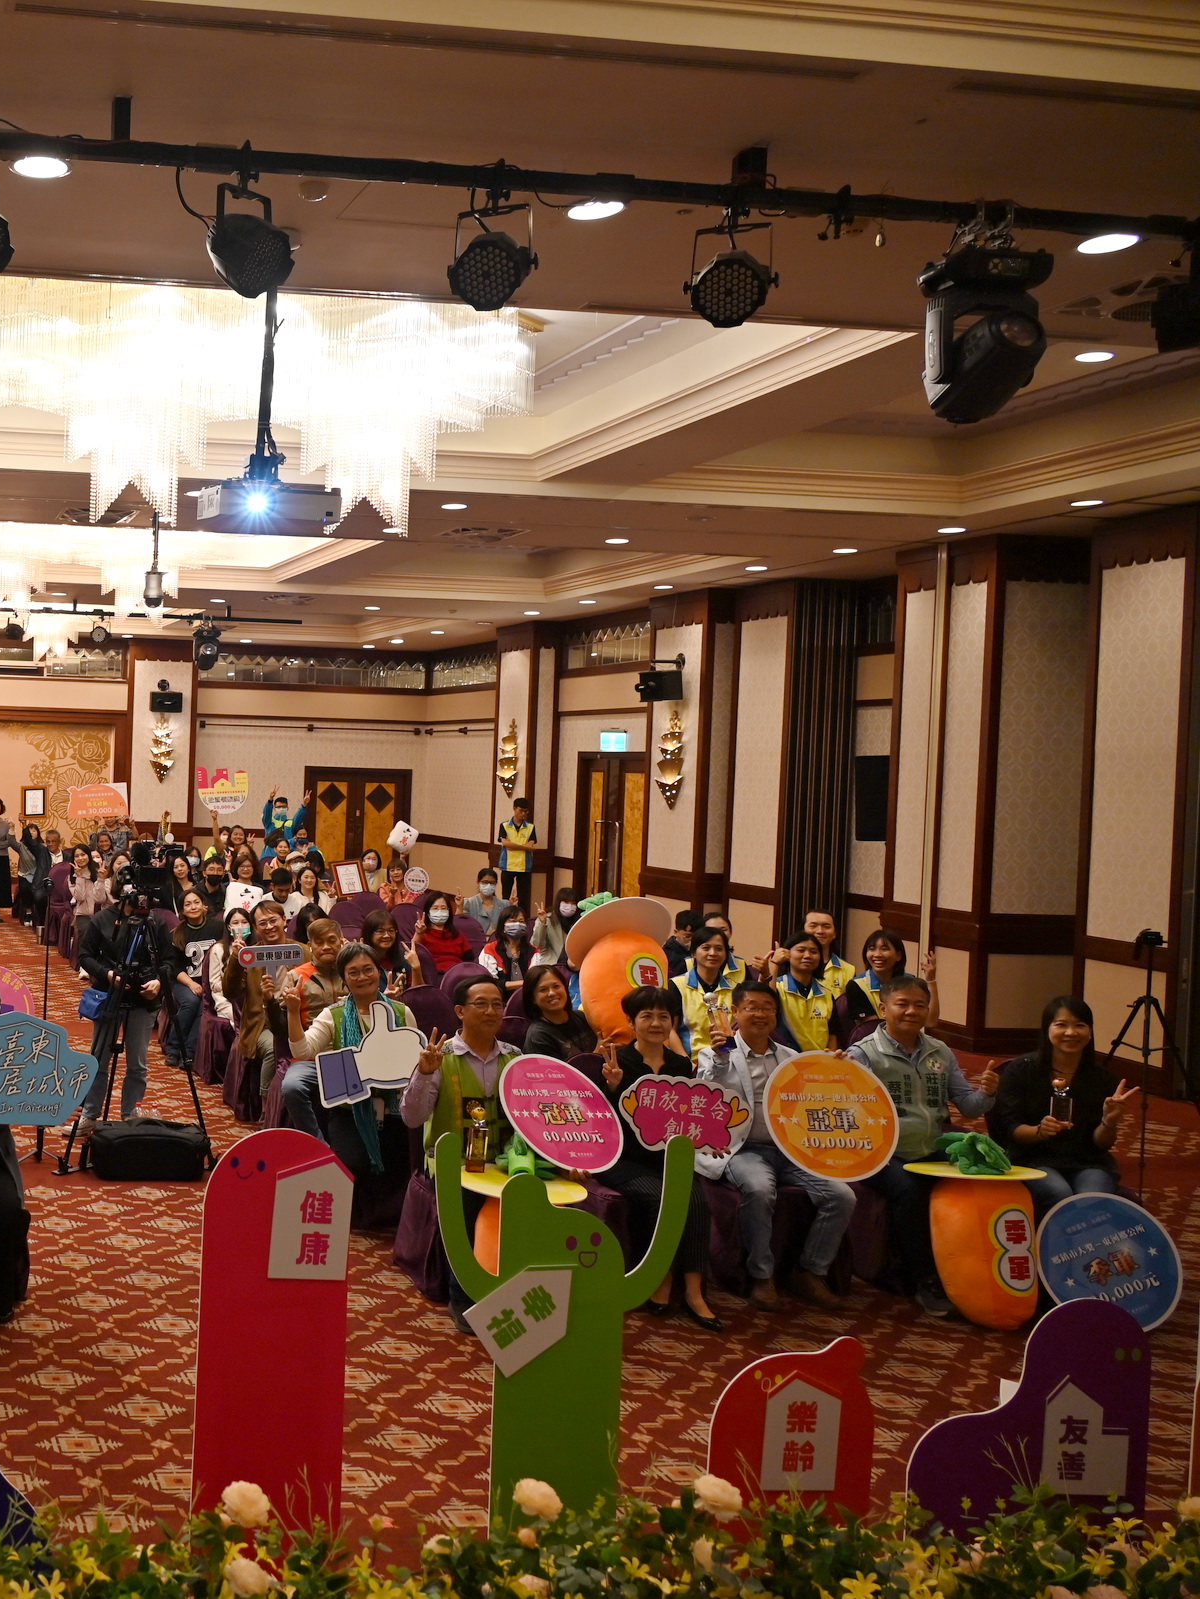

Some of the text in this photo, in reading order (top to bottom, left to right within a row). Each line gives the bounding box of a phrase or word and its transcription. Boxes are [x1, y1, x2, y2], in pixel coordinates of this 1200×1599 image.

[256, 950, 301, 961] 臺東愛健康
[0, 1104, 14, 1114] In
[19, 1102, 63, 1117] Taitung!
[538, 1101, 588, 1126] 冠軍
[805, 1107, 860, 1133] 亞軍
[543, 1130, 605, 1144] 60,000元
[663, 1117, 703, 1141] 創新
[801, 1135, 873, 1150] 40,000元
[295, 1190, 333, 1266] 健康
[1082, 1249, 1141, 1287] 季軍
[486, 1284, 558, 1350] 幸福
[781, 1400, 819, 1473] 樂齡
[1057, 1415, 1089, 1482] 友善
